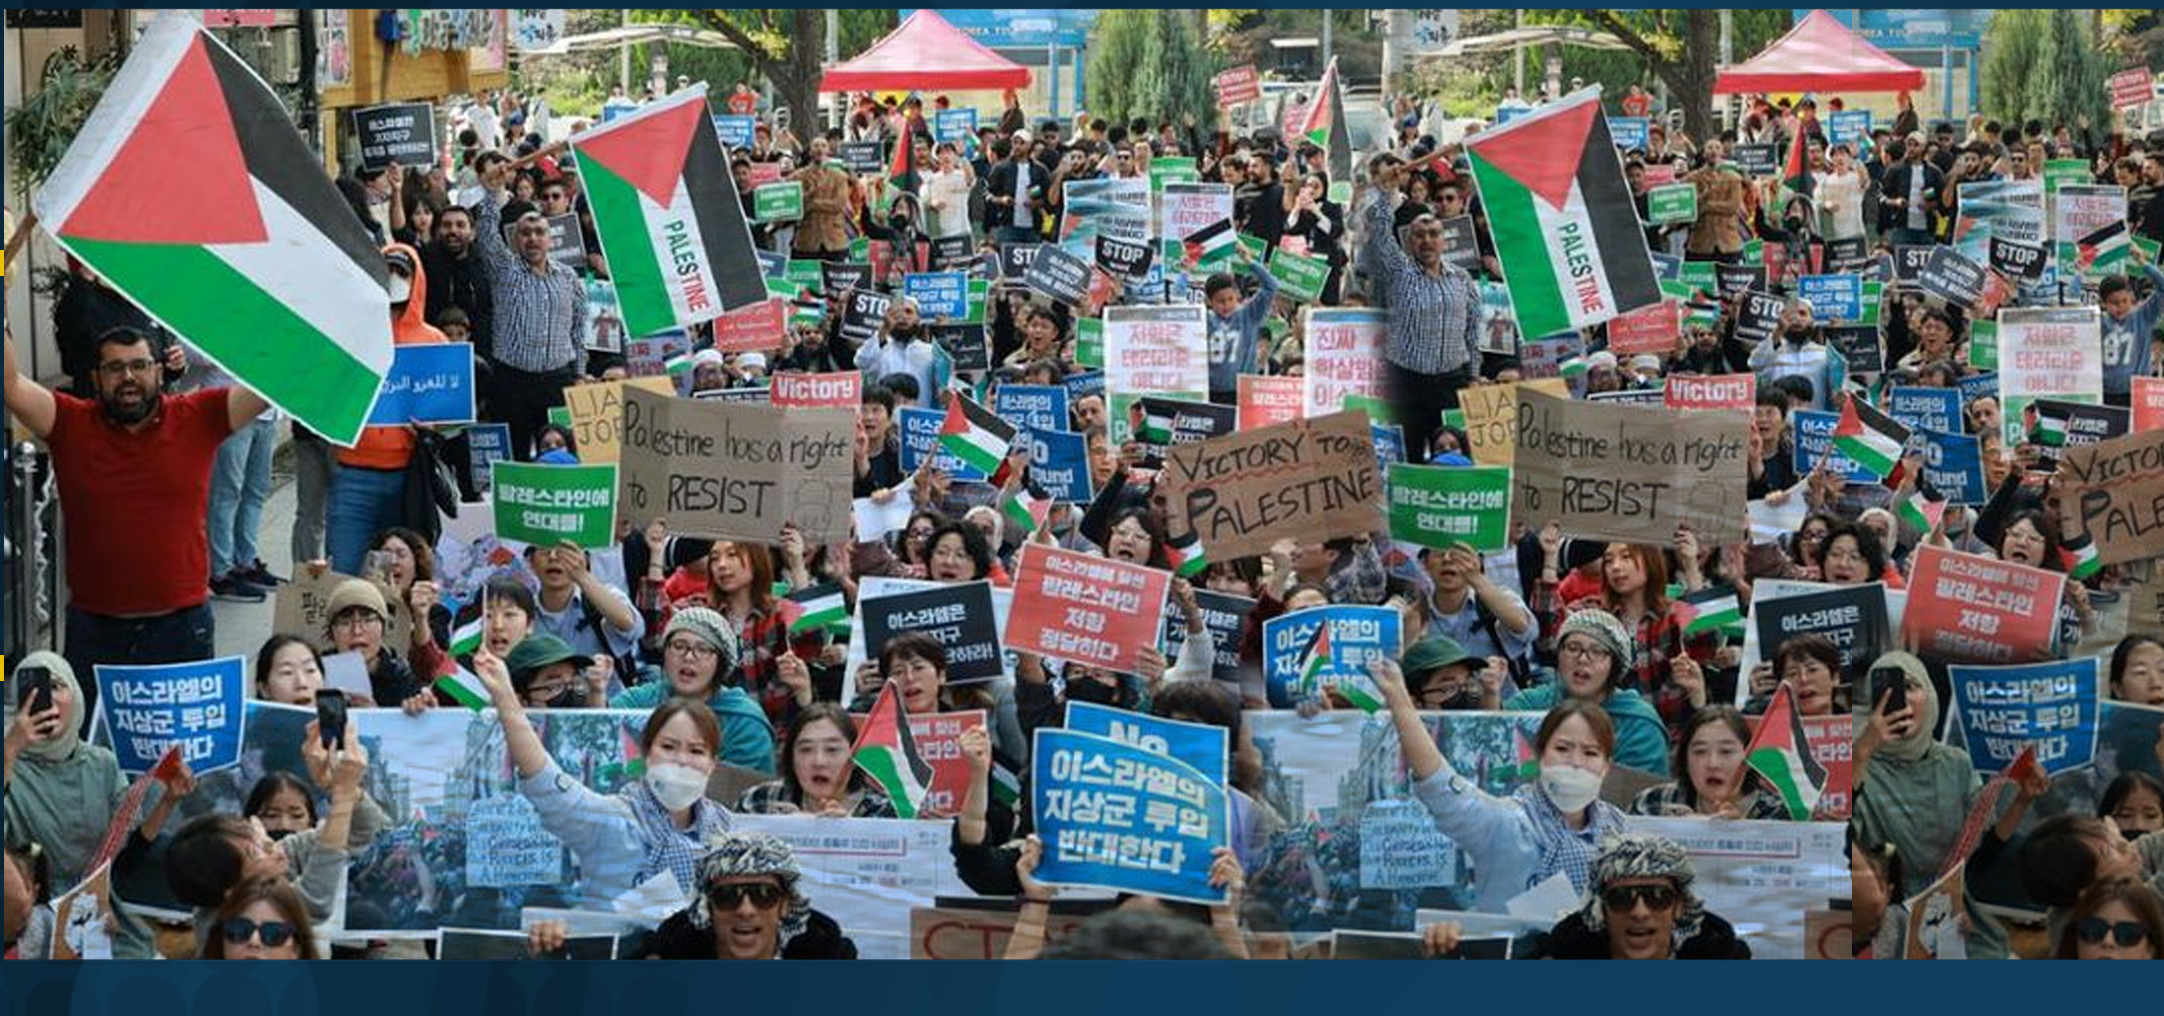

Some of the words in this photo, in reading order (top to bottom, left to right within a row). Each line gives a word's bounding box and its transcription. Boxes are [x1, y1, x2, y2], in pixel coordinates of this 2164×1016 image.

[663, 219, 712, 313] PALESTINE
[1012, 247, 1037, 266] ST
[1102, 241, 1144, 264] STOP
[1557, 221, 1606, 315] PALESTINE
[1906, 249, 1931, 268] ST
[1996, 243, 2038, 266] STOP
[1210, 330, 1240, 364] 87
[2104, 332, 2134, 366] 87
[777, 374, 853, 400] Victory
[1671, 376, 1747, 402] Victory
[622, 401, 714, 458] Palestine
[726, 417, 766, 462] has
[767, 438, 783, 463] a
[789, 432, 849, 470] right
[1516, 403, 1608, 460] Palestine
[1620, 419, 1660, 464] has
[1661, 440, 1677, 465] a
[1683, 434, 1743, 472] right
[1172, 433, 1306, 484] VICTORY
[1316, 435, 1351, 457] TO
[628, 472, 648, 509] to
[667, 473, 776, 519] RESIST
[1185, 467, 1373, 542] PALESTINE
[1522, 474, 1542, 511] to
[1561, 475, 1670, 521] RESIST
[112, 673, 224, 705] 이스라엘의
[1966, 673, 2078, 705] 이스라엘의
[114, 705, 176, 735] 지상군
[181, 702, 227, 732] 투입
[1968, 705, 2030, 735] 지상군
[2035, 702, 2081, 732] 투입
[1051, 750, 1206, 809] 이스라엘의
[1044, 789, 1137, 828] 지상군
[1144, 799, 1209, 842] 투입
[1058, 828, 1187, 875] 반대한다
